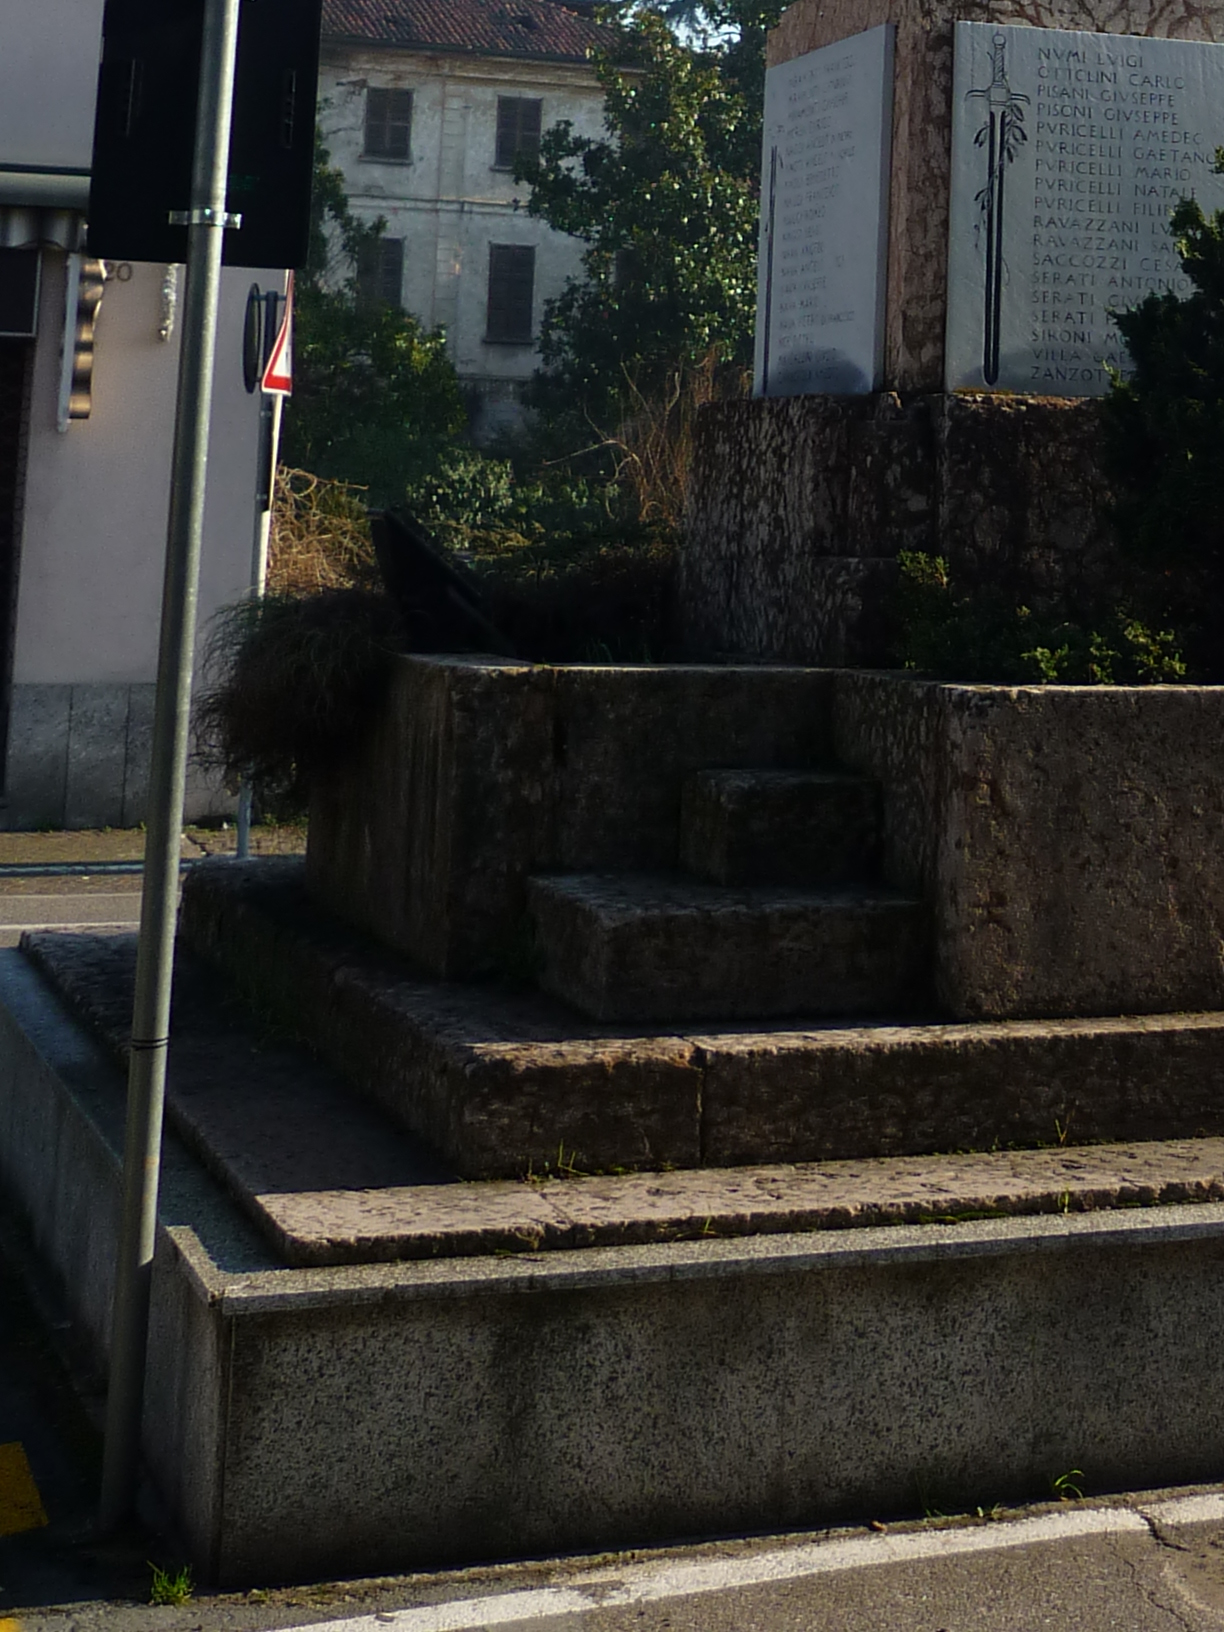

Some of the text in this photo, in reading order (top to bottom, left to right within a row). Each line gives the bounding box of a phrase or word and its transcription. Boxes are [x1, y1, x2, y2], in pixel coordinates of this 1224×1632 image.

[1097, 52, 1143, 69] LVIGI
[1129, 73, 1186, 90] CARLO
[1037, 84, 1175, 108] PISANI GIVSEPPE
[1037, 102, 1179, 125] PISONI GIVSEPPE
[1036, 121, 1204, 146] PVRICELLI AMEDEO
[1035, 139, 1122, 159] PVRICELLI
[1035, 158, 1191, 181] PVRICELLI MARIO
[1034, 177, 1121, 196] PVRICELLI
[1034, 196, 1120, 213] PVRICELLI
[1033, 215, 1139, 234] RAVAZZANI
[1032, 234, 1138, 253] RAVAZZANI
[1032, 252, 1127, 271] SACCOZZI
[1032, 271, 1189, 291] SERATI ANTONIO
[1031, 290, 1095, 305] SERATI
[1031, 310, 1094, 325] SERATI
[1033, 348, 1081, 363] VILLA
